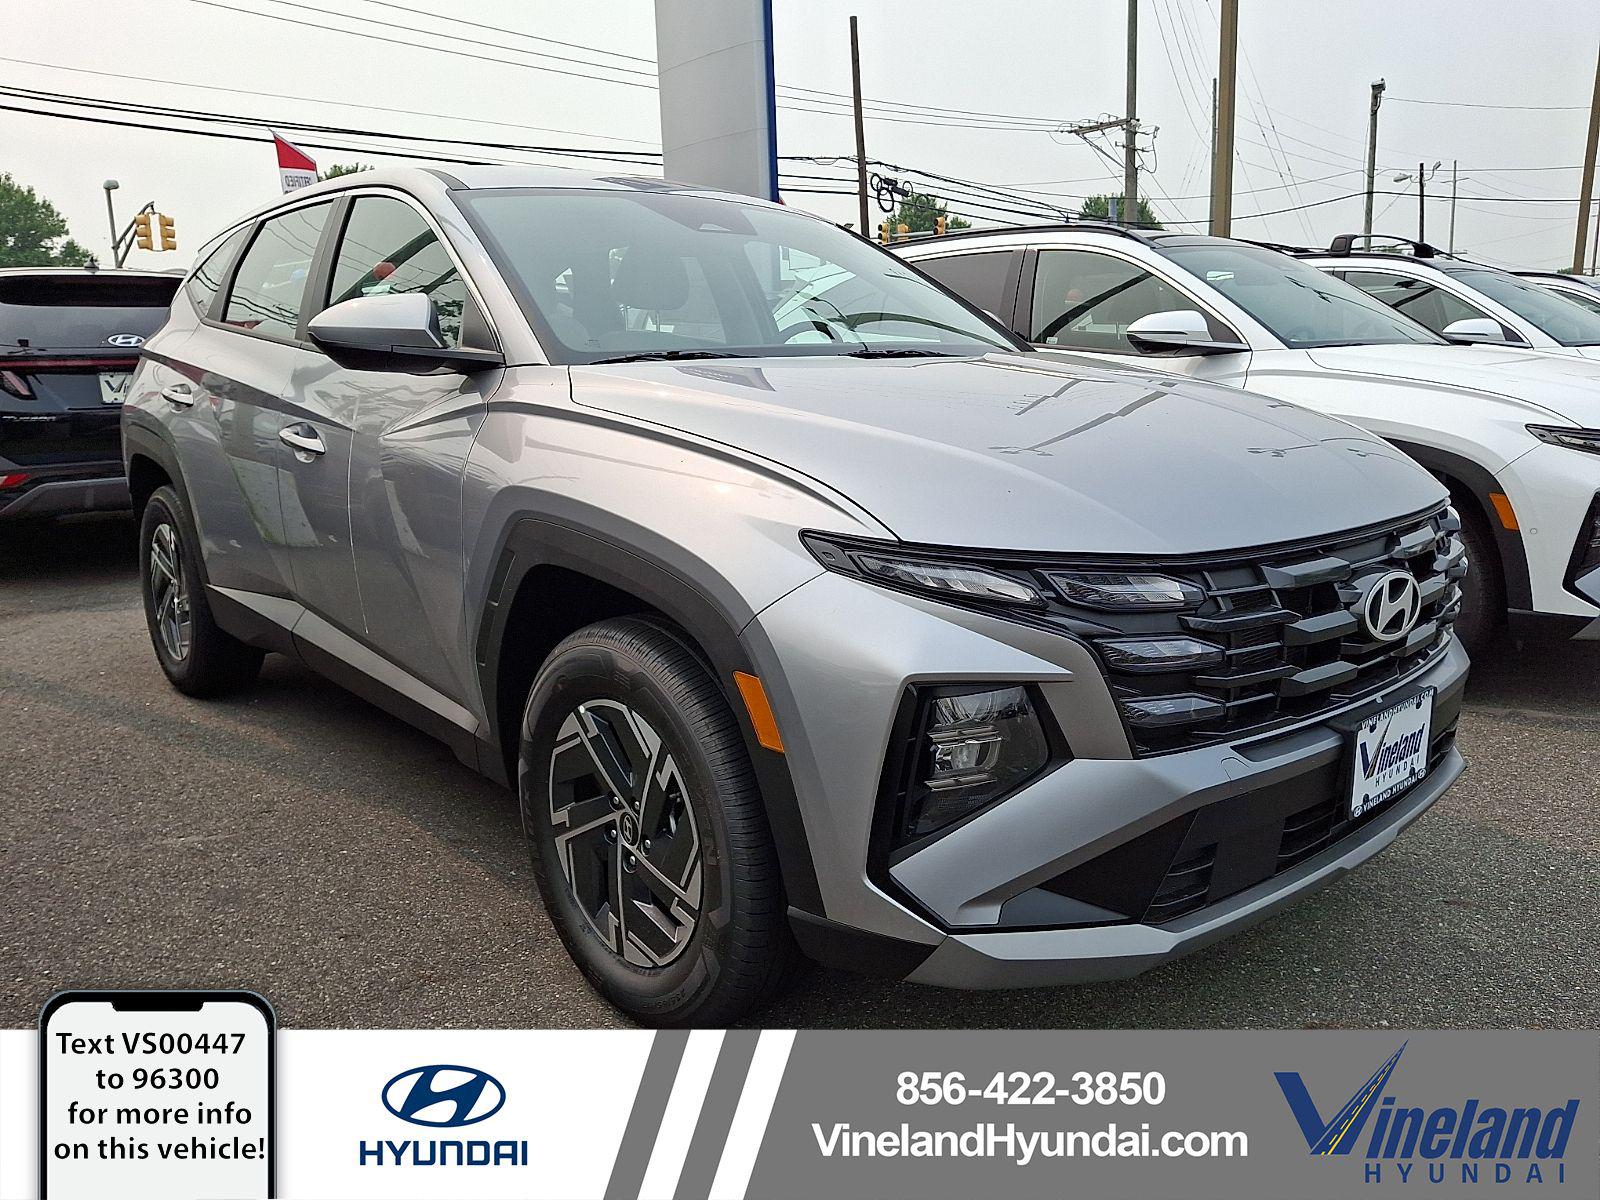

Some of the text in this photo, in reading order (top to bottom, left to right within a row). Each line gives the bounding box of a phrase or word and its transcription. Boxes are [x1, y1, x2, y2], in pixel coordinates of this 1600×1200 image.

[1360, 715, 1425, 781] Vineland
[1363, 771, 1418, 812] VINELAND HYUNDAI
[1375, 756, 1420, 788] HYUNDAI
